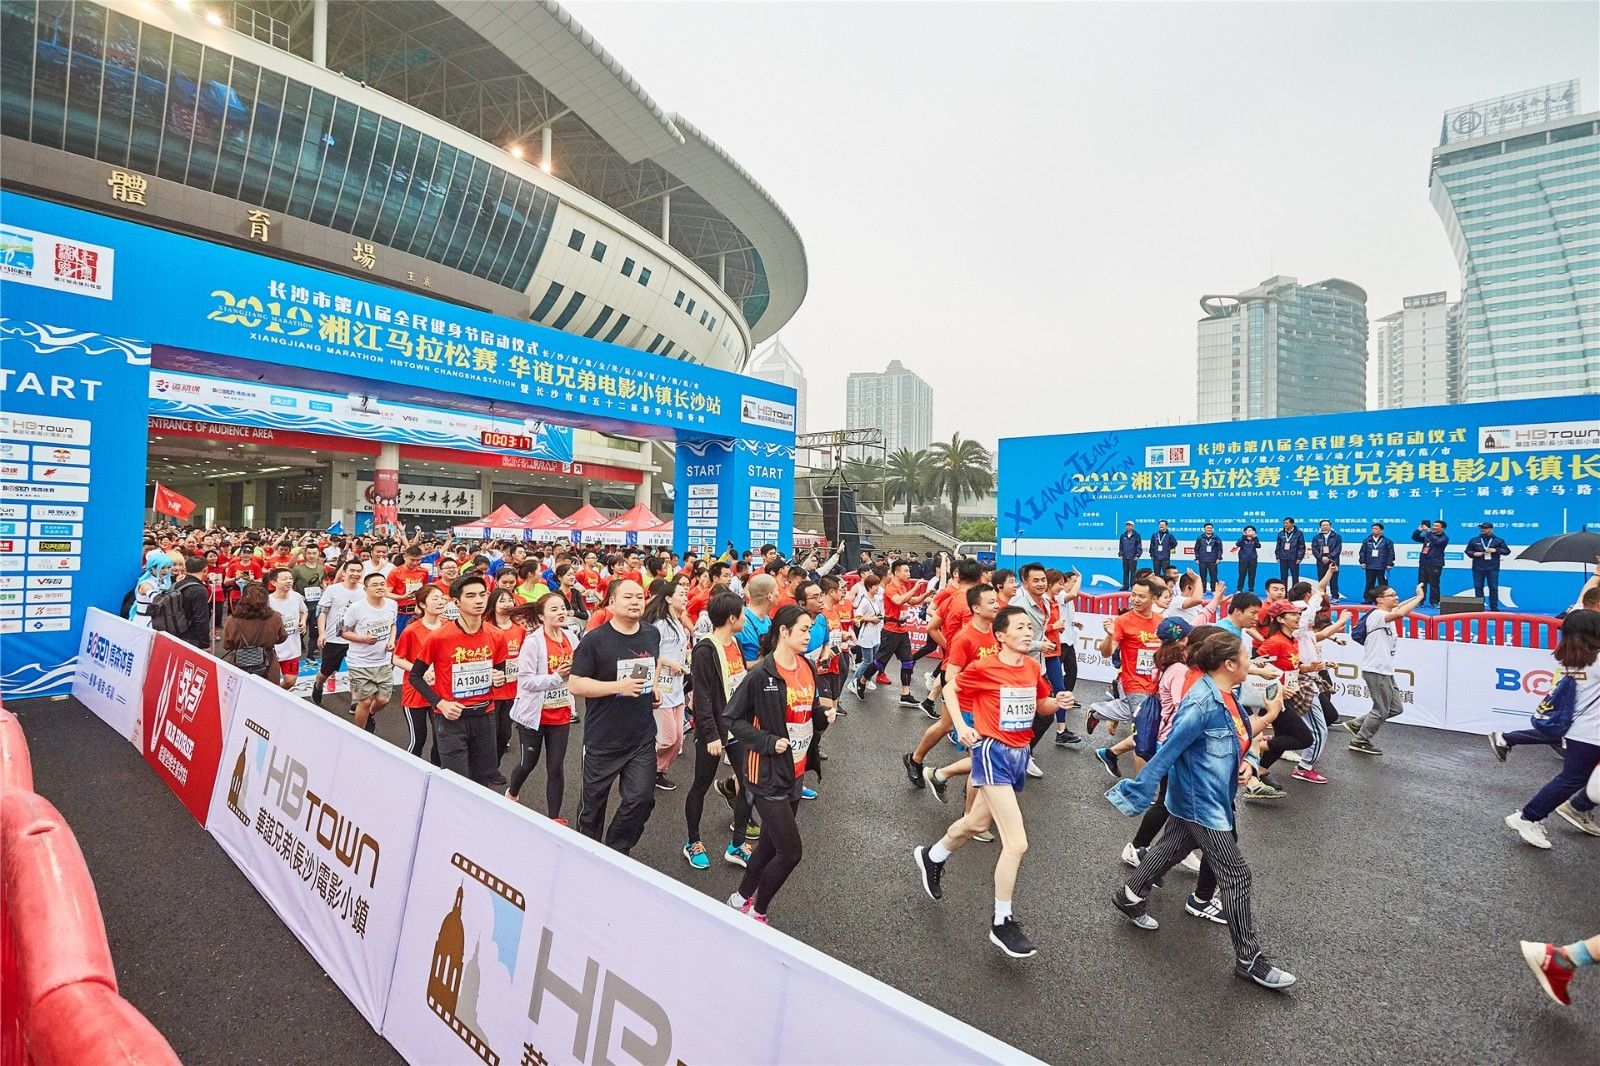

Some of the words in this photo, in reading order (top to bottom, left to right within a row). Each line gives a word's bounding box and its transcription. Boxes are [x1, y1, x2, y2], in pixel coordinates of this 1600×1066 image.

[206, 289, 314, 337] 2019
[267, 279, 539, 356] 长沙市第八届全民健身节启动仪式
[249, 332, 322, 353] XIANGJIANG
[325, 346, 385, 364] MARATHON
[389, 358, 431, 373] HBTOWN
[433, 366, 482, 382] CHANGSHA
[195, 423, 208, 434] OF
[208, 424, 250, 438] AUDIENCE
[252, 428, 274, 440] AREA
[484, 433, 532, 449] 00:03:17
[1197, 428, 1467, 456] 长沙市第八届全民健身节启动仪式
[686, 464, 722, 477] START
[747, 464, 784, 479] START
[1070, 471, 1129, 494] 2019
[1217, 490, 1264, 498] CHANGSHA
[456, 674, 490, 687] A13043
